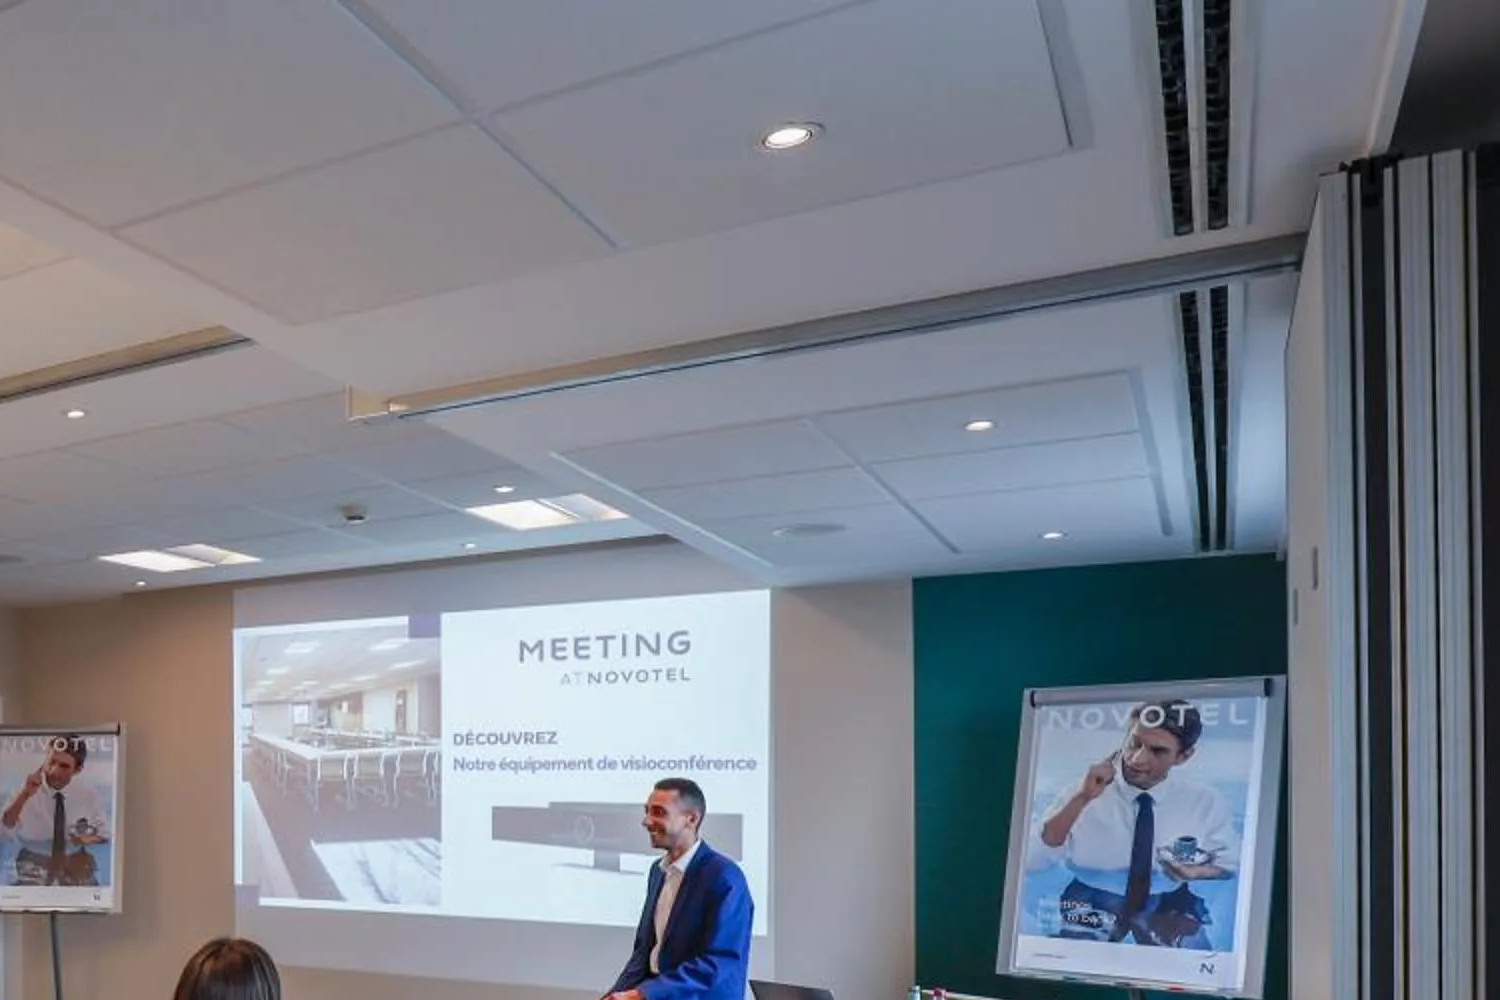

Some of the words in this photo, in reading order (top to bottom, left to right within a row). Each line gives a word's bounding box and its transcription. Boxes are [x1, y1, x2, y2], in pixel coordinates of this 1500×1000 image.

[518, 630, 691, 663] MEETING
[559, 672, 583, 685] AT
[587, 667, 691, 685] NOVOTEL
[1049, 703, 1249, 731] NOVOTEL
[1, 737, 113, 753] NOVOTEL
[452, 729, 558, 746] DÉCOUVREZ
[453, 756, 496, 771] Notre
[499, 755, 594, 774] équipement
[596, 756, 618, 771] de
[620, 755, 757, 771] visioconférence
